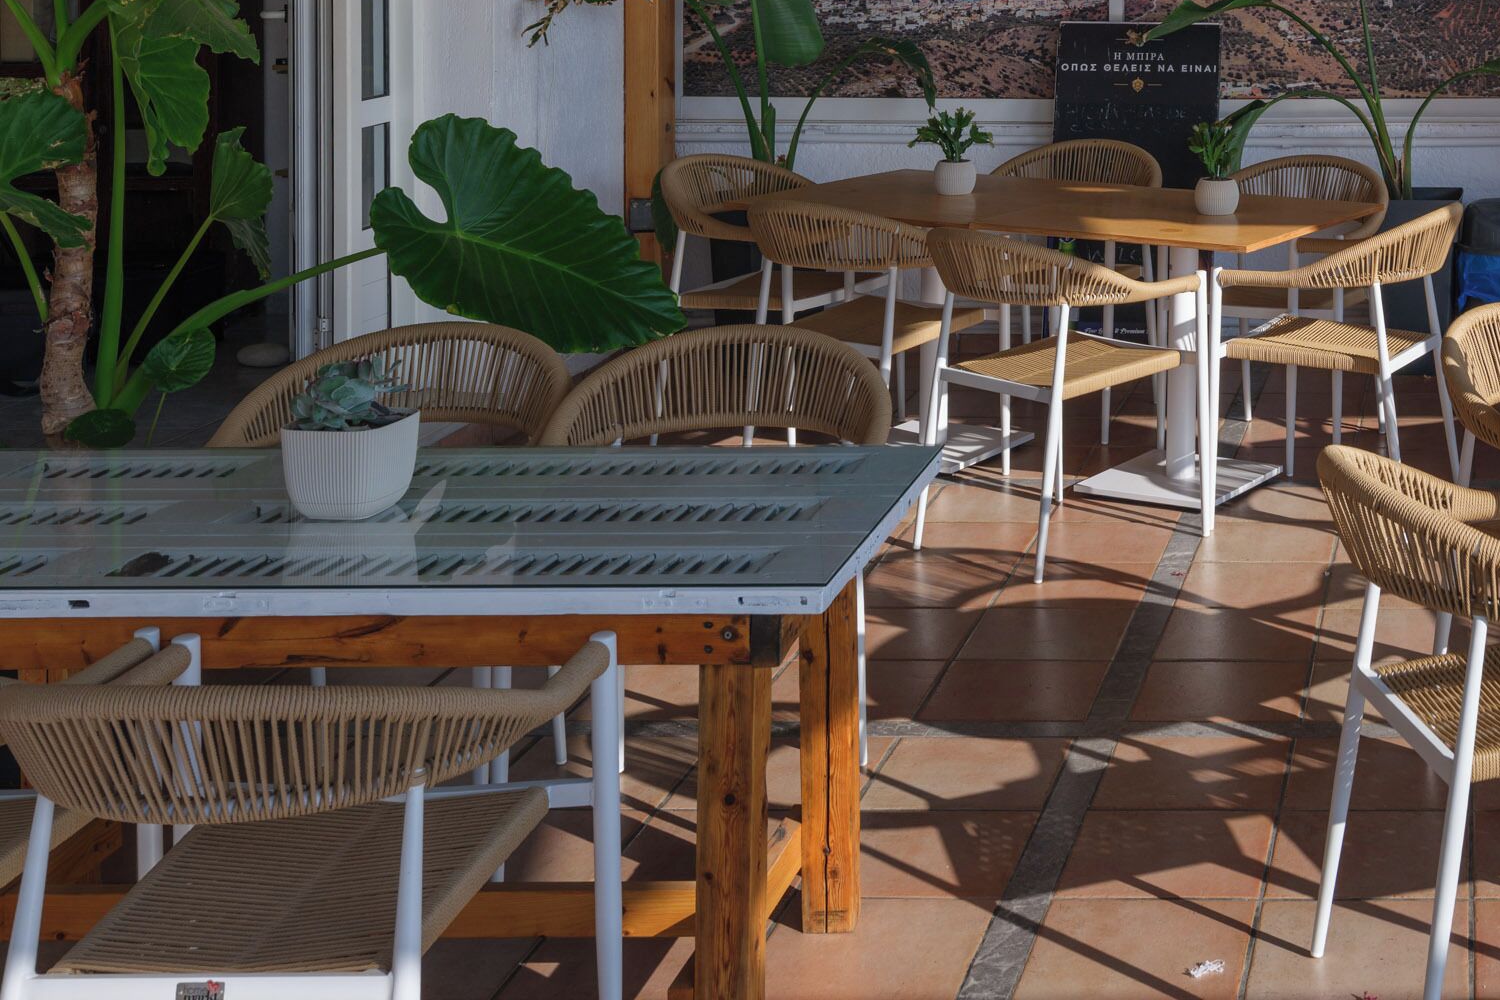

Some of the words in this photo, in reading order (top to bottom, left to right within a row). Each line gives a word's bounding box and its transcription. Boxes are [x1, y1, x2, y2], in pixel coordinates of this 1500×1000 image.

[1114, 52, 1122, 61] Η
[1126, 52, 1165, 61] ΜΠΙΡΑ
[1061, 63, 1097, 72] ΟΠΩΣ
[1103, 64, 1152, 73] ΘΕΛΕΙΣ
[1157, 64, 1175, 73] ΝΑ
[1181, 64, 1217, 73] ΕΙΝΑΙ
